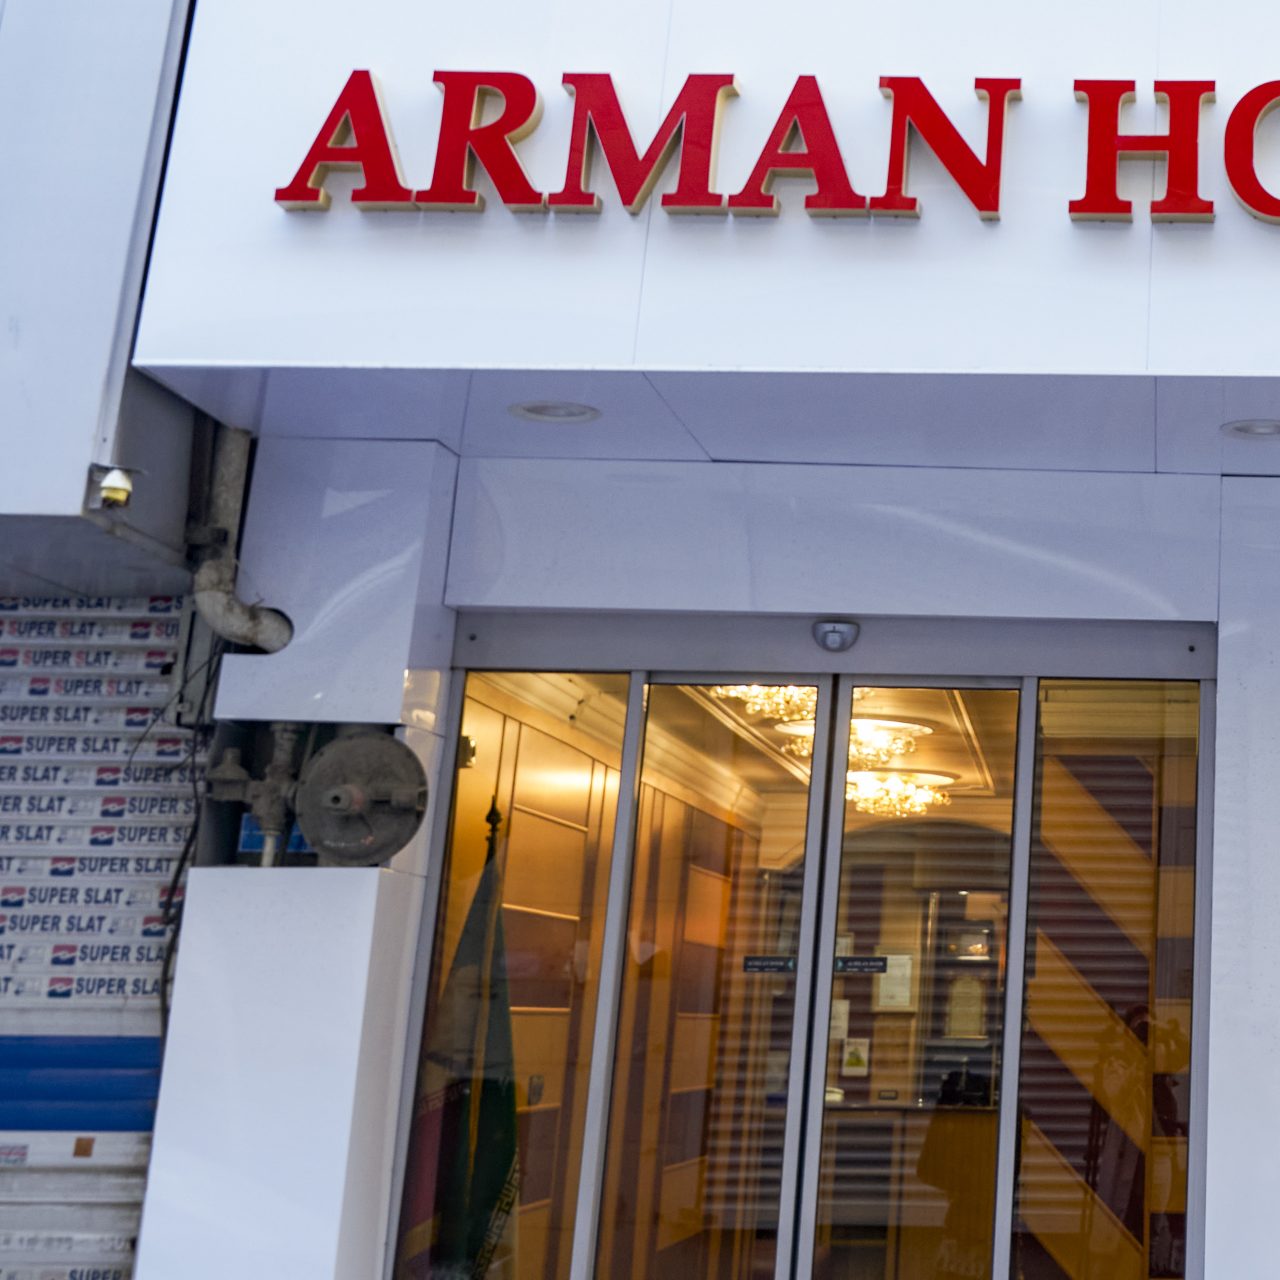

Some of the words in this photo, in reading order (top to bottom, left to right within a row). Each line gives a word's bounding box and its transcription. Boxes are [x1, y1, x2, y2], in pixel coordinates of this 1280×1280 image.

[275, 69, 1022, 220] ARMAN
[8, 621, 54, 637] SUPER
[60, 622, 96, 637] SLAT
[23, 650, 71, 665] SUPER
[75, 651, 111, 666] SLAT
[54, 679, 102, 695] SUPER
[107, 680, 143, 696] SLAT
[1, 706, 50, 721] SUPER
[54, 707, 92, 722] SLAT
[25, 737, 79, 752] SUPER
[81, 737, 121, 753] SLAT
[22, 767, 61, 782] SLAT
[122, 768, 173, 783] SUPER
[27, 796, 66, 812] SLAT
[127, 797, 178, 813] SUPER
[16, 826, 54, 841] SLAT
[117, 826, 168, 842] SUPER
[78, 857, 128, 872] SUPER
[134, 858, 172, 873] SLAT
[27, 887, 79, 903] SUPER
[84, 888, 124, 904] SLAT
[8, 915, 61, 931] SUPER
[66, 916, 106, 932] SLAT
[79, 945, 131, 961] SUPER
[75, 978, 127, 994] SUPER
